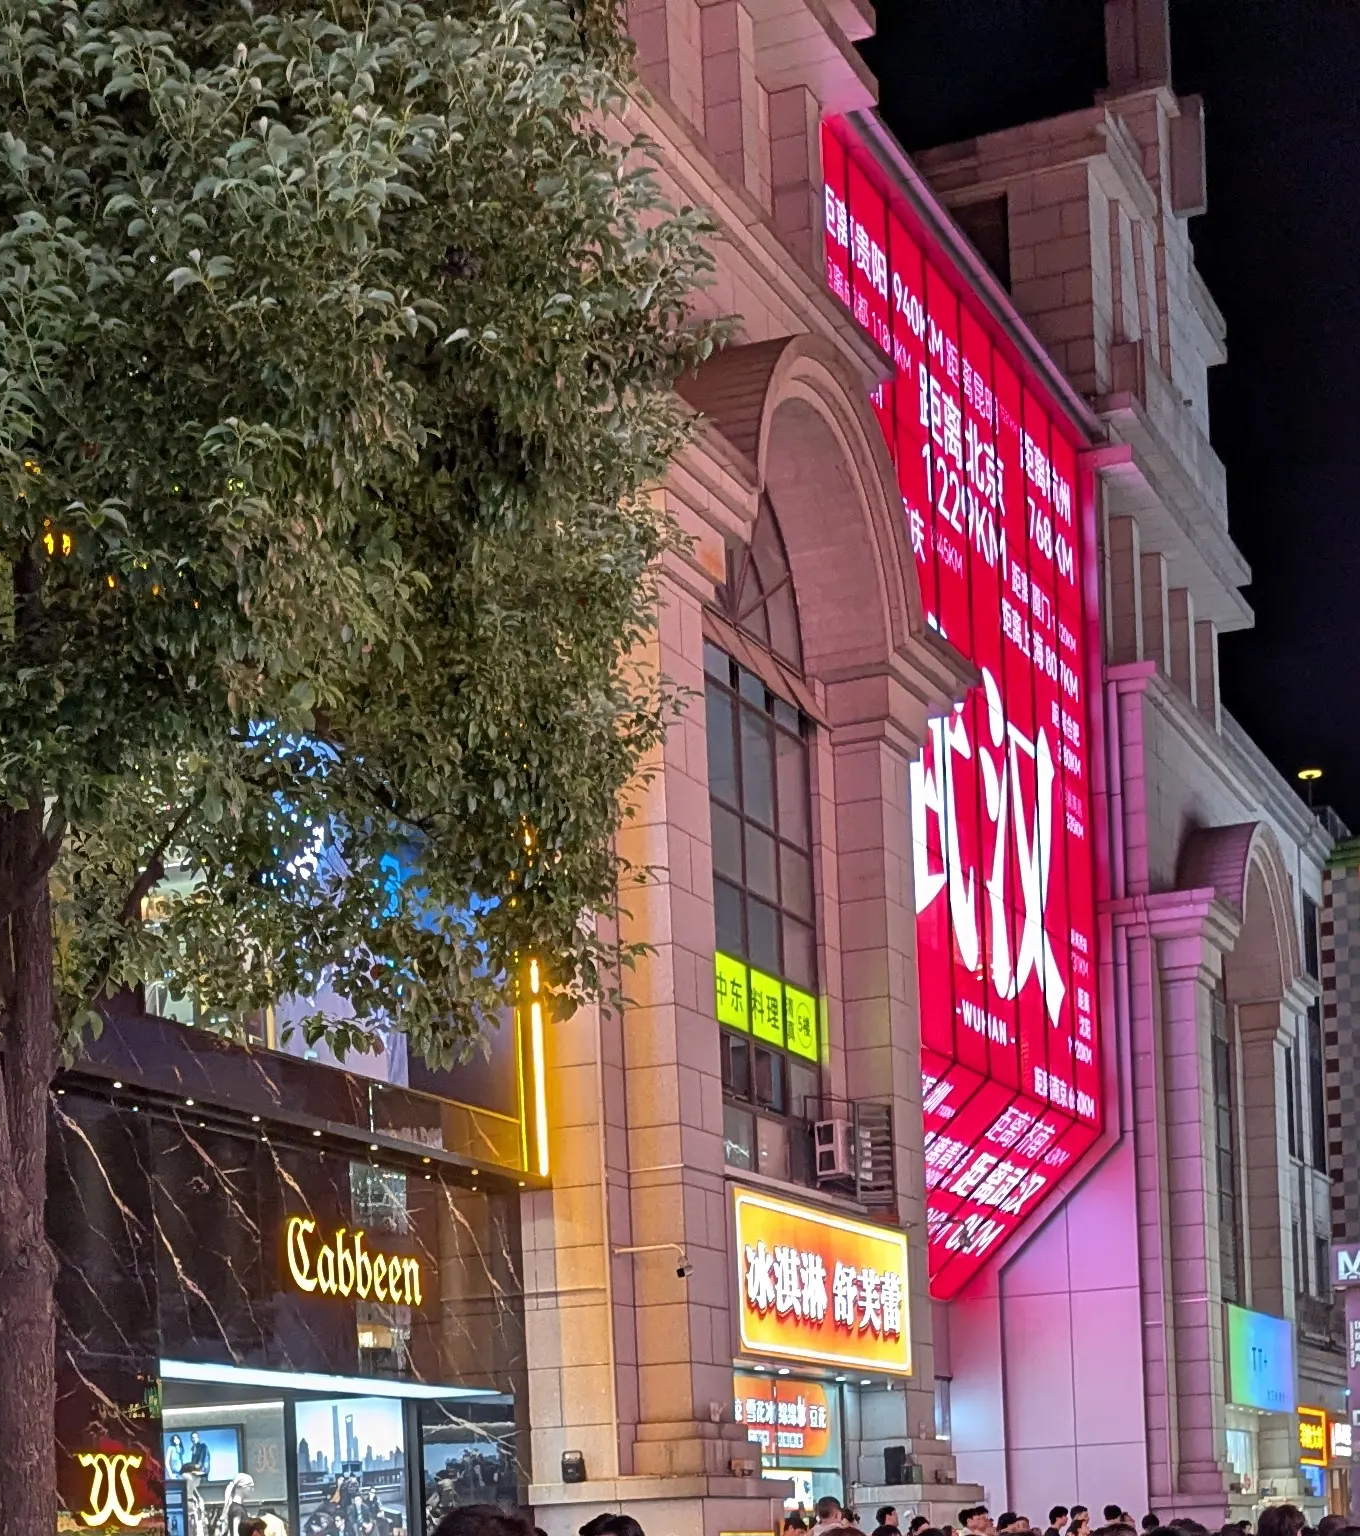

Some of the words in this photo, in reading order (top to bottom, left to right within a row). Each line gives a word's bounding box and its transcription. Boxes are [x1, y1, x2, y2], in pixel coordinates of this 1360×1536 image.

[919, 360, 1006, 517] 距离北京
[910, 666, 1066, 1028] 武汉
[715, 970, 780, 1031] 中东料理
[961, 998, 1008, 1047] WUHAN
[949, 1152, 1047, 1217] 距离武汉
[286, 1216, 423, 1306] Cabbeen
[745, 1239, 829, 1323] 冰淇淋
[832, 1258, 903, 1338] 舒芙蕾
[745, 1398, 776, 1425] 雪花冰
[809, 1405, 828, 1429] 豆花
